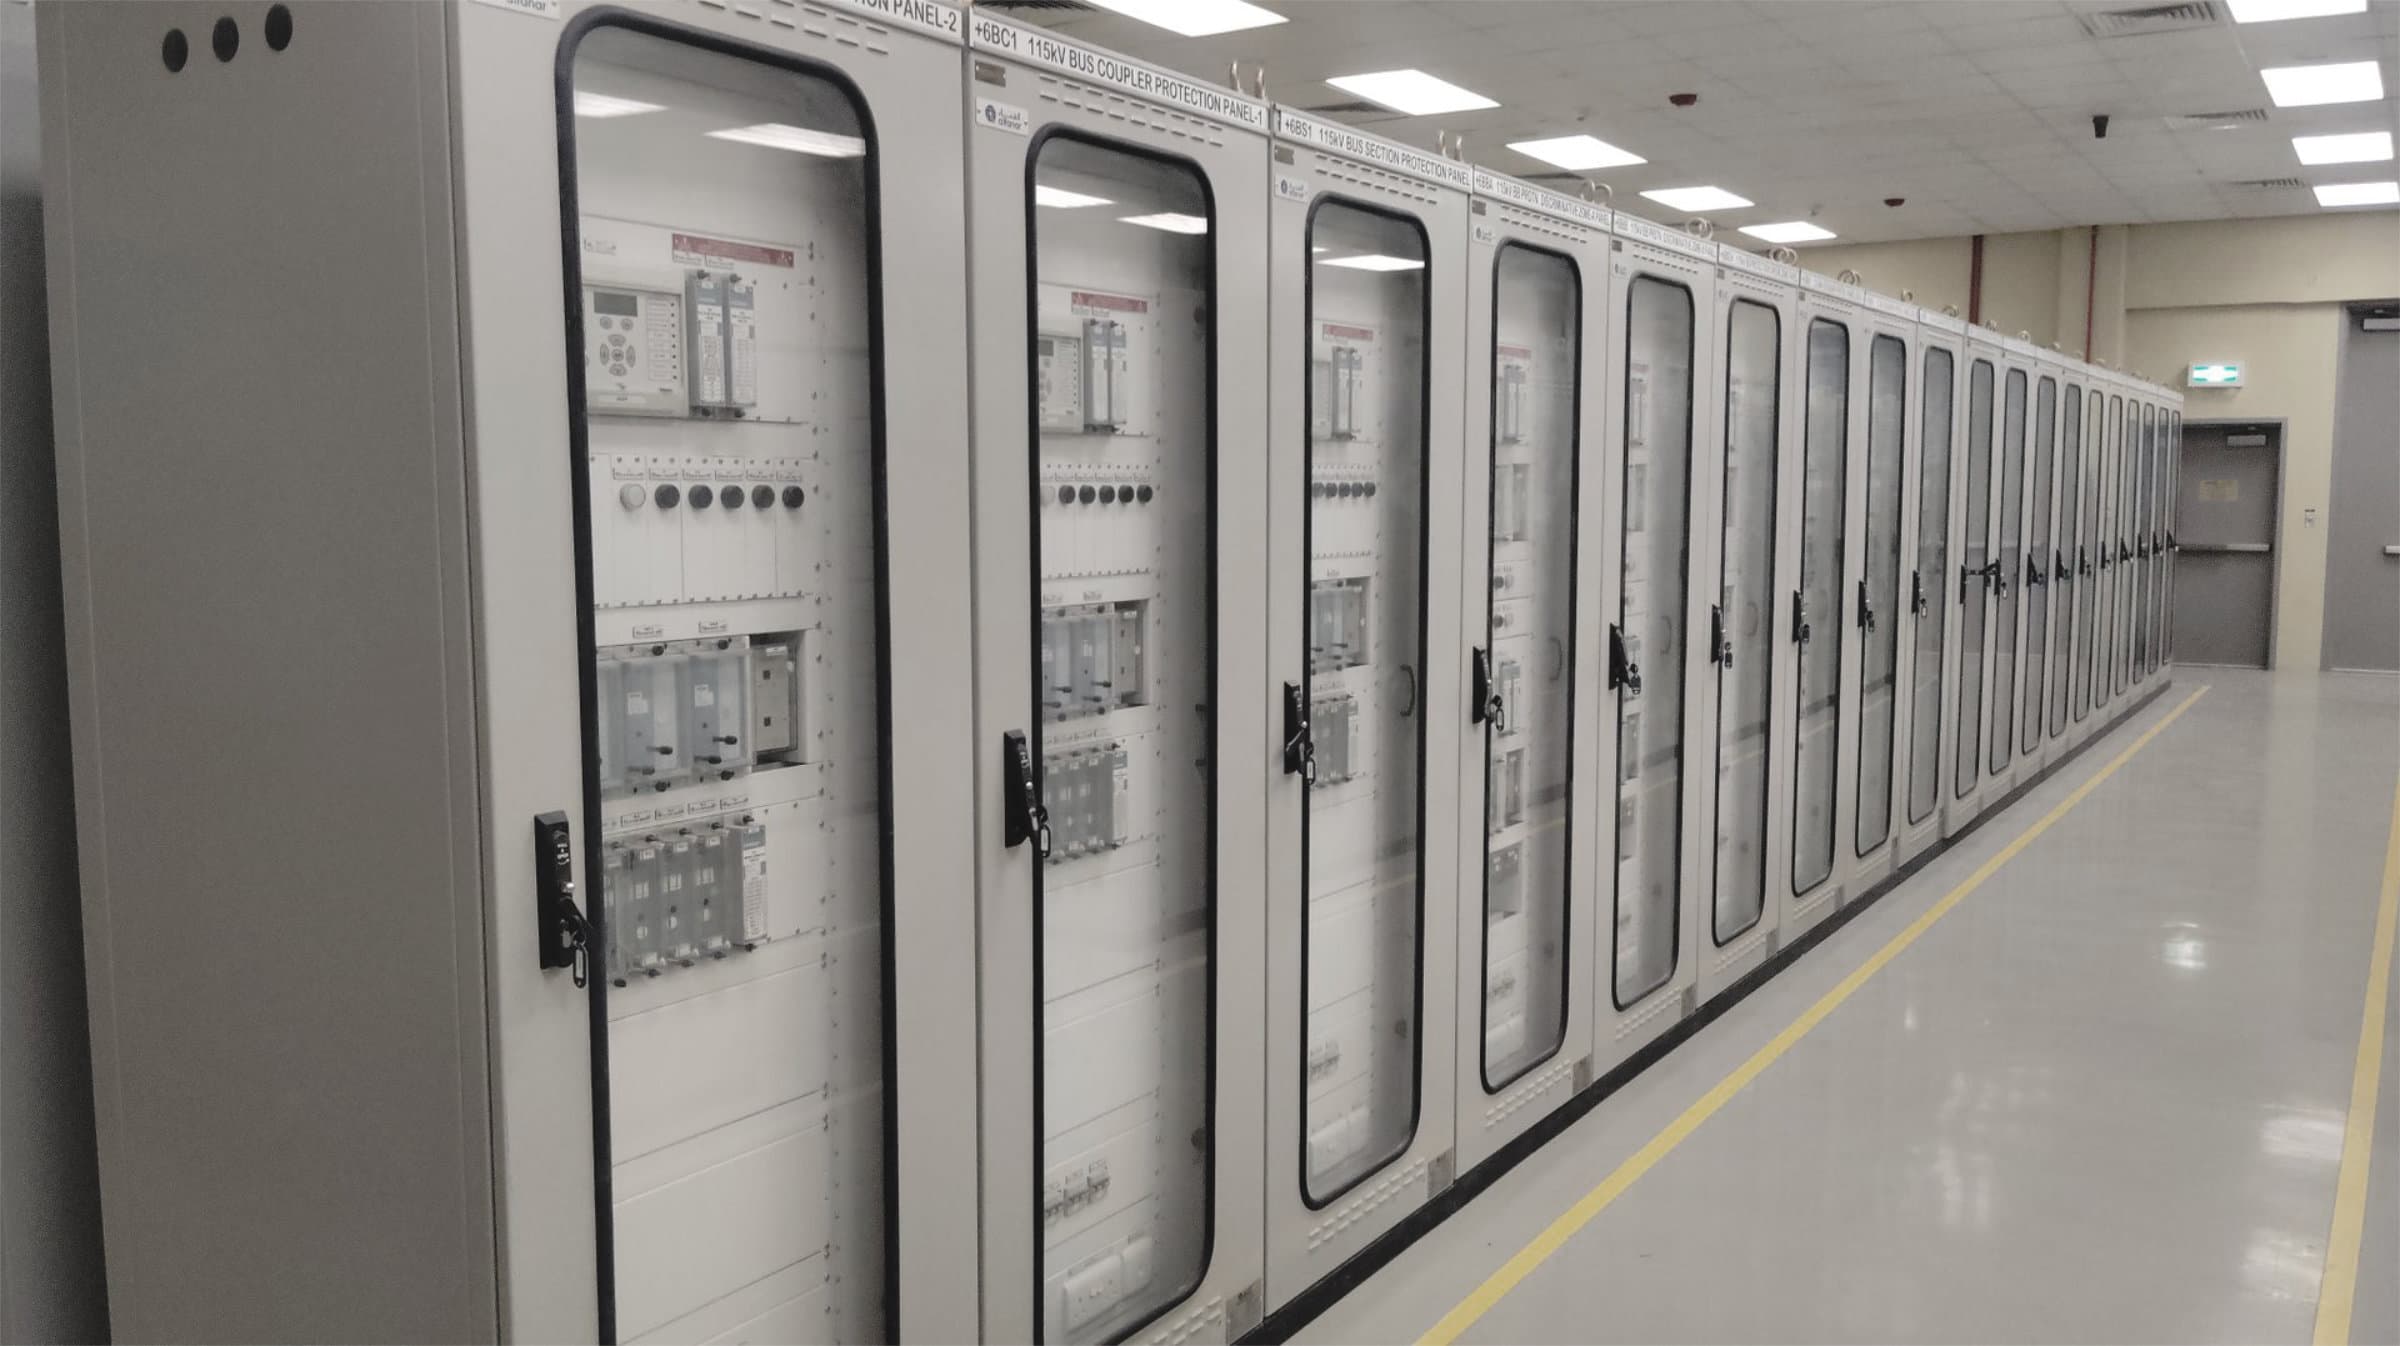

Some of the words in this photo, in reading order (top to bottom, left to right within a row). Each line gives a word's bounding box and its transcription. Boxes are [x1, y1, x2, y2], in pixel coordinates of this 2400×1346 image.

[893, 0, 957, 32] PANEL-2
[975, 22, 1017, 50] +6BC1
[1028, 36, 1066, 65] 115kV
[1069, 49, 1095, 74] BUS
[1097, 58, 1152, 93] COUPLER
[1154, 76, 1221, 113] PROTECTION
[1223, 98, 1263, 126] PANEL-1
[1285, 118, 1312, 140] +6BS1
[1320, 127, 1345, 149] 115kV
[1346, 135, 1364, 154] BUS
[1365, 141, 1400, 165] SECTION
[1401, 152, 1447, 179] PROTECTION
[1448, 166, 1471, 186] PANEL
